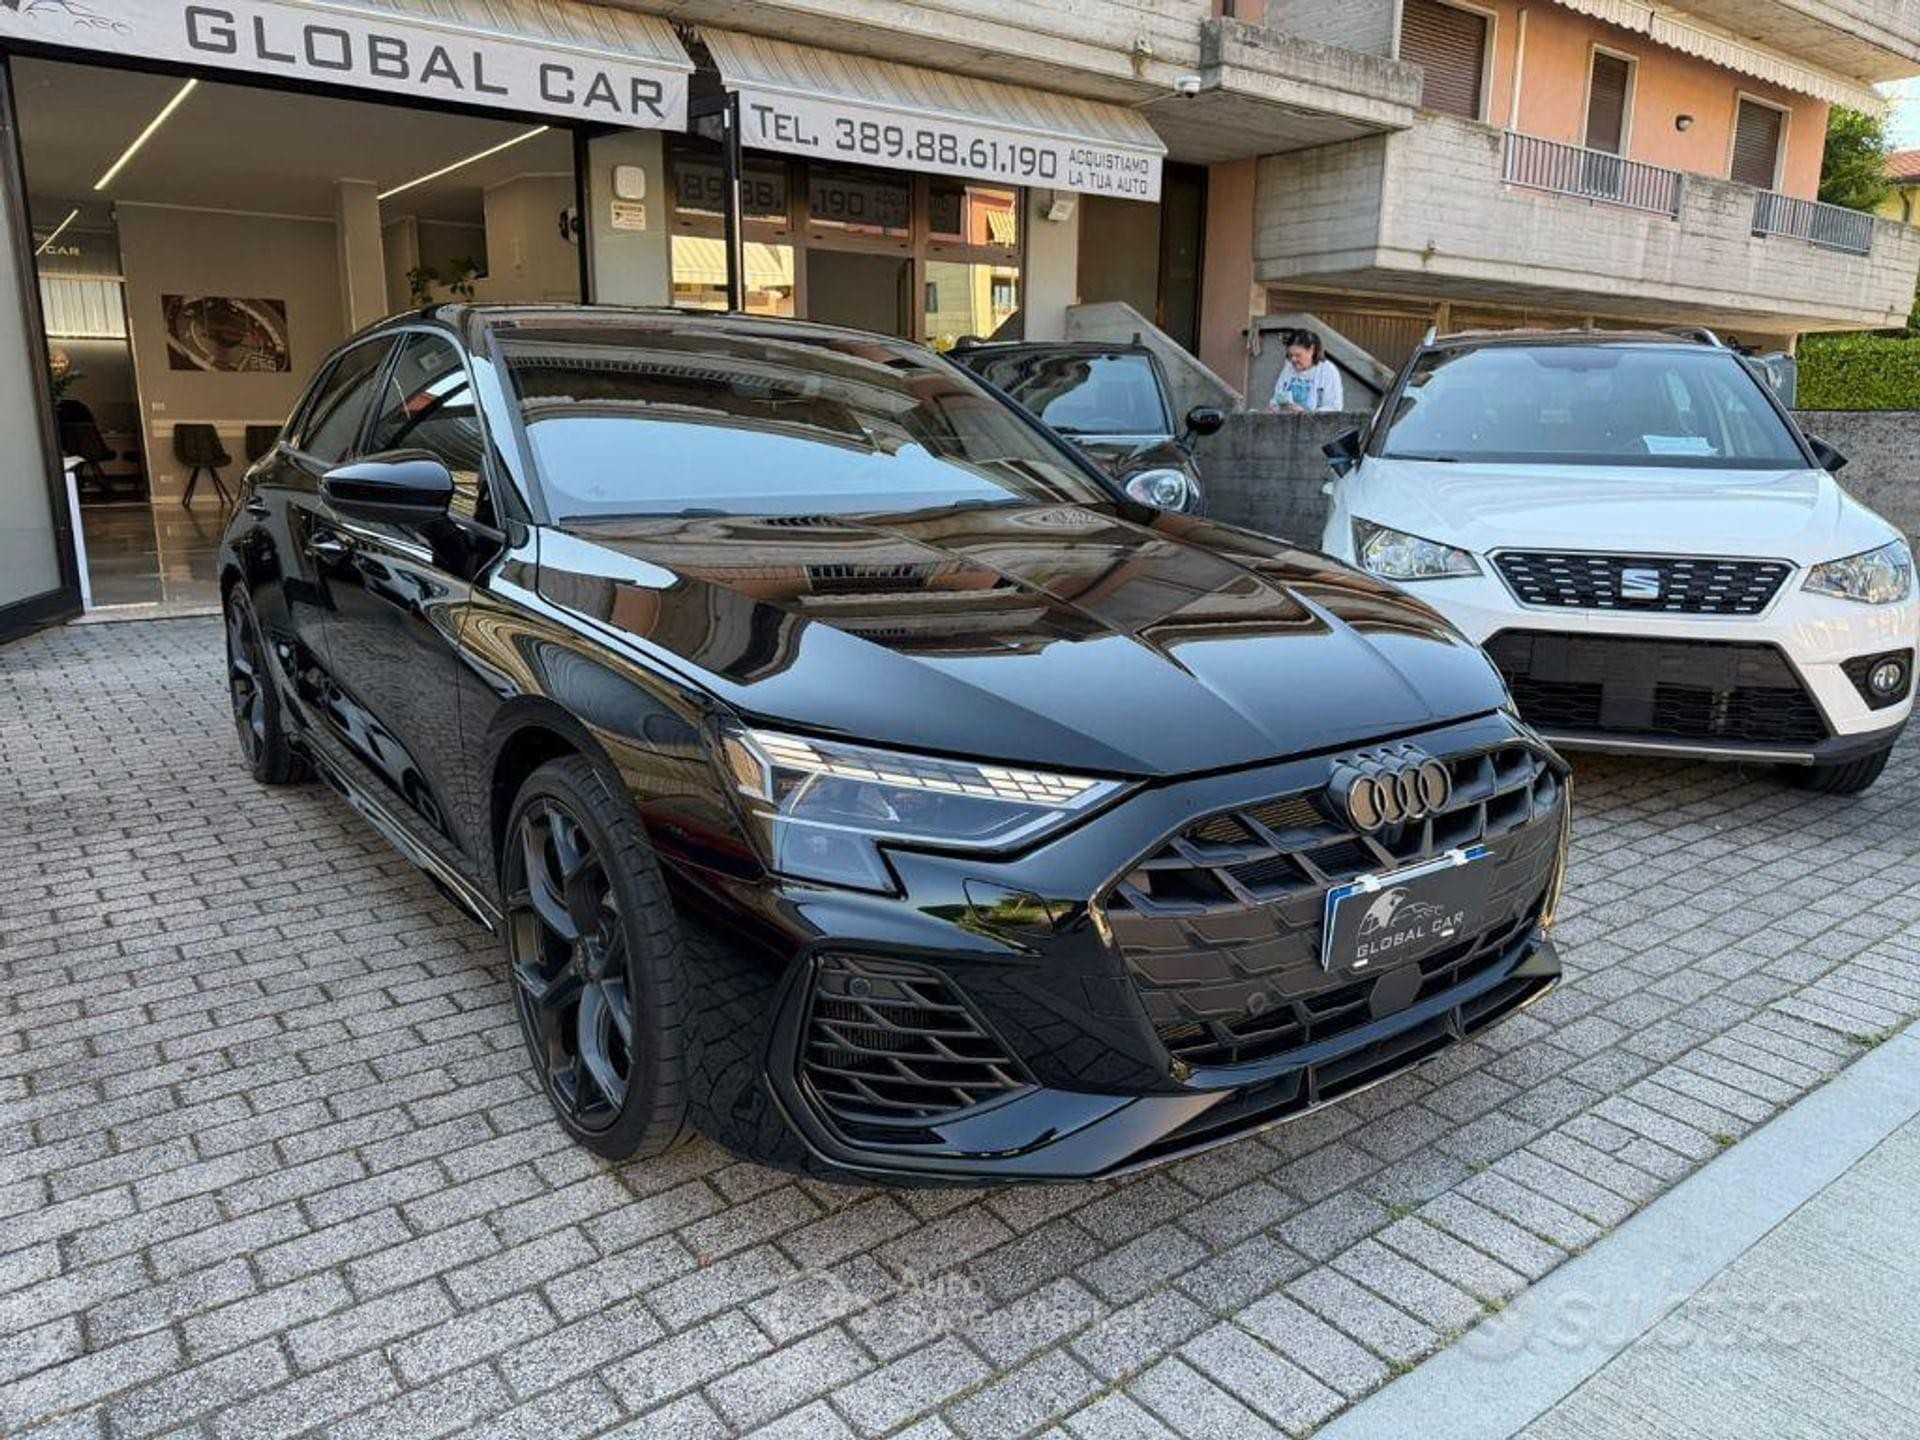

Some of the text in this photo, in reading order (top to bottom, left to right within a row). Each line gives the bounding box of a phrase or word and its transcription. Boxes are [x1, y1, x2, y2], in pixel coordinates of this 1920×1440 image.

[185, 5, 664, 119] GLOBAL CAR
[751, 104, 1057, 180] TEL. 389.88.61.190
[1068, 149, 1149, 174] ACQUISTIAMO
[1068, 169, 1148, 195] LA TUA AUTO
[1356, 910, 1465, 958] GLOBAL CAR
